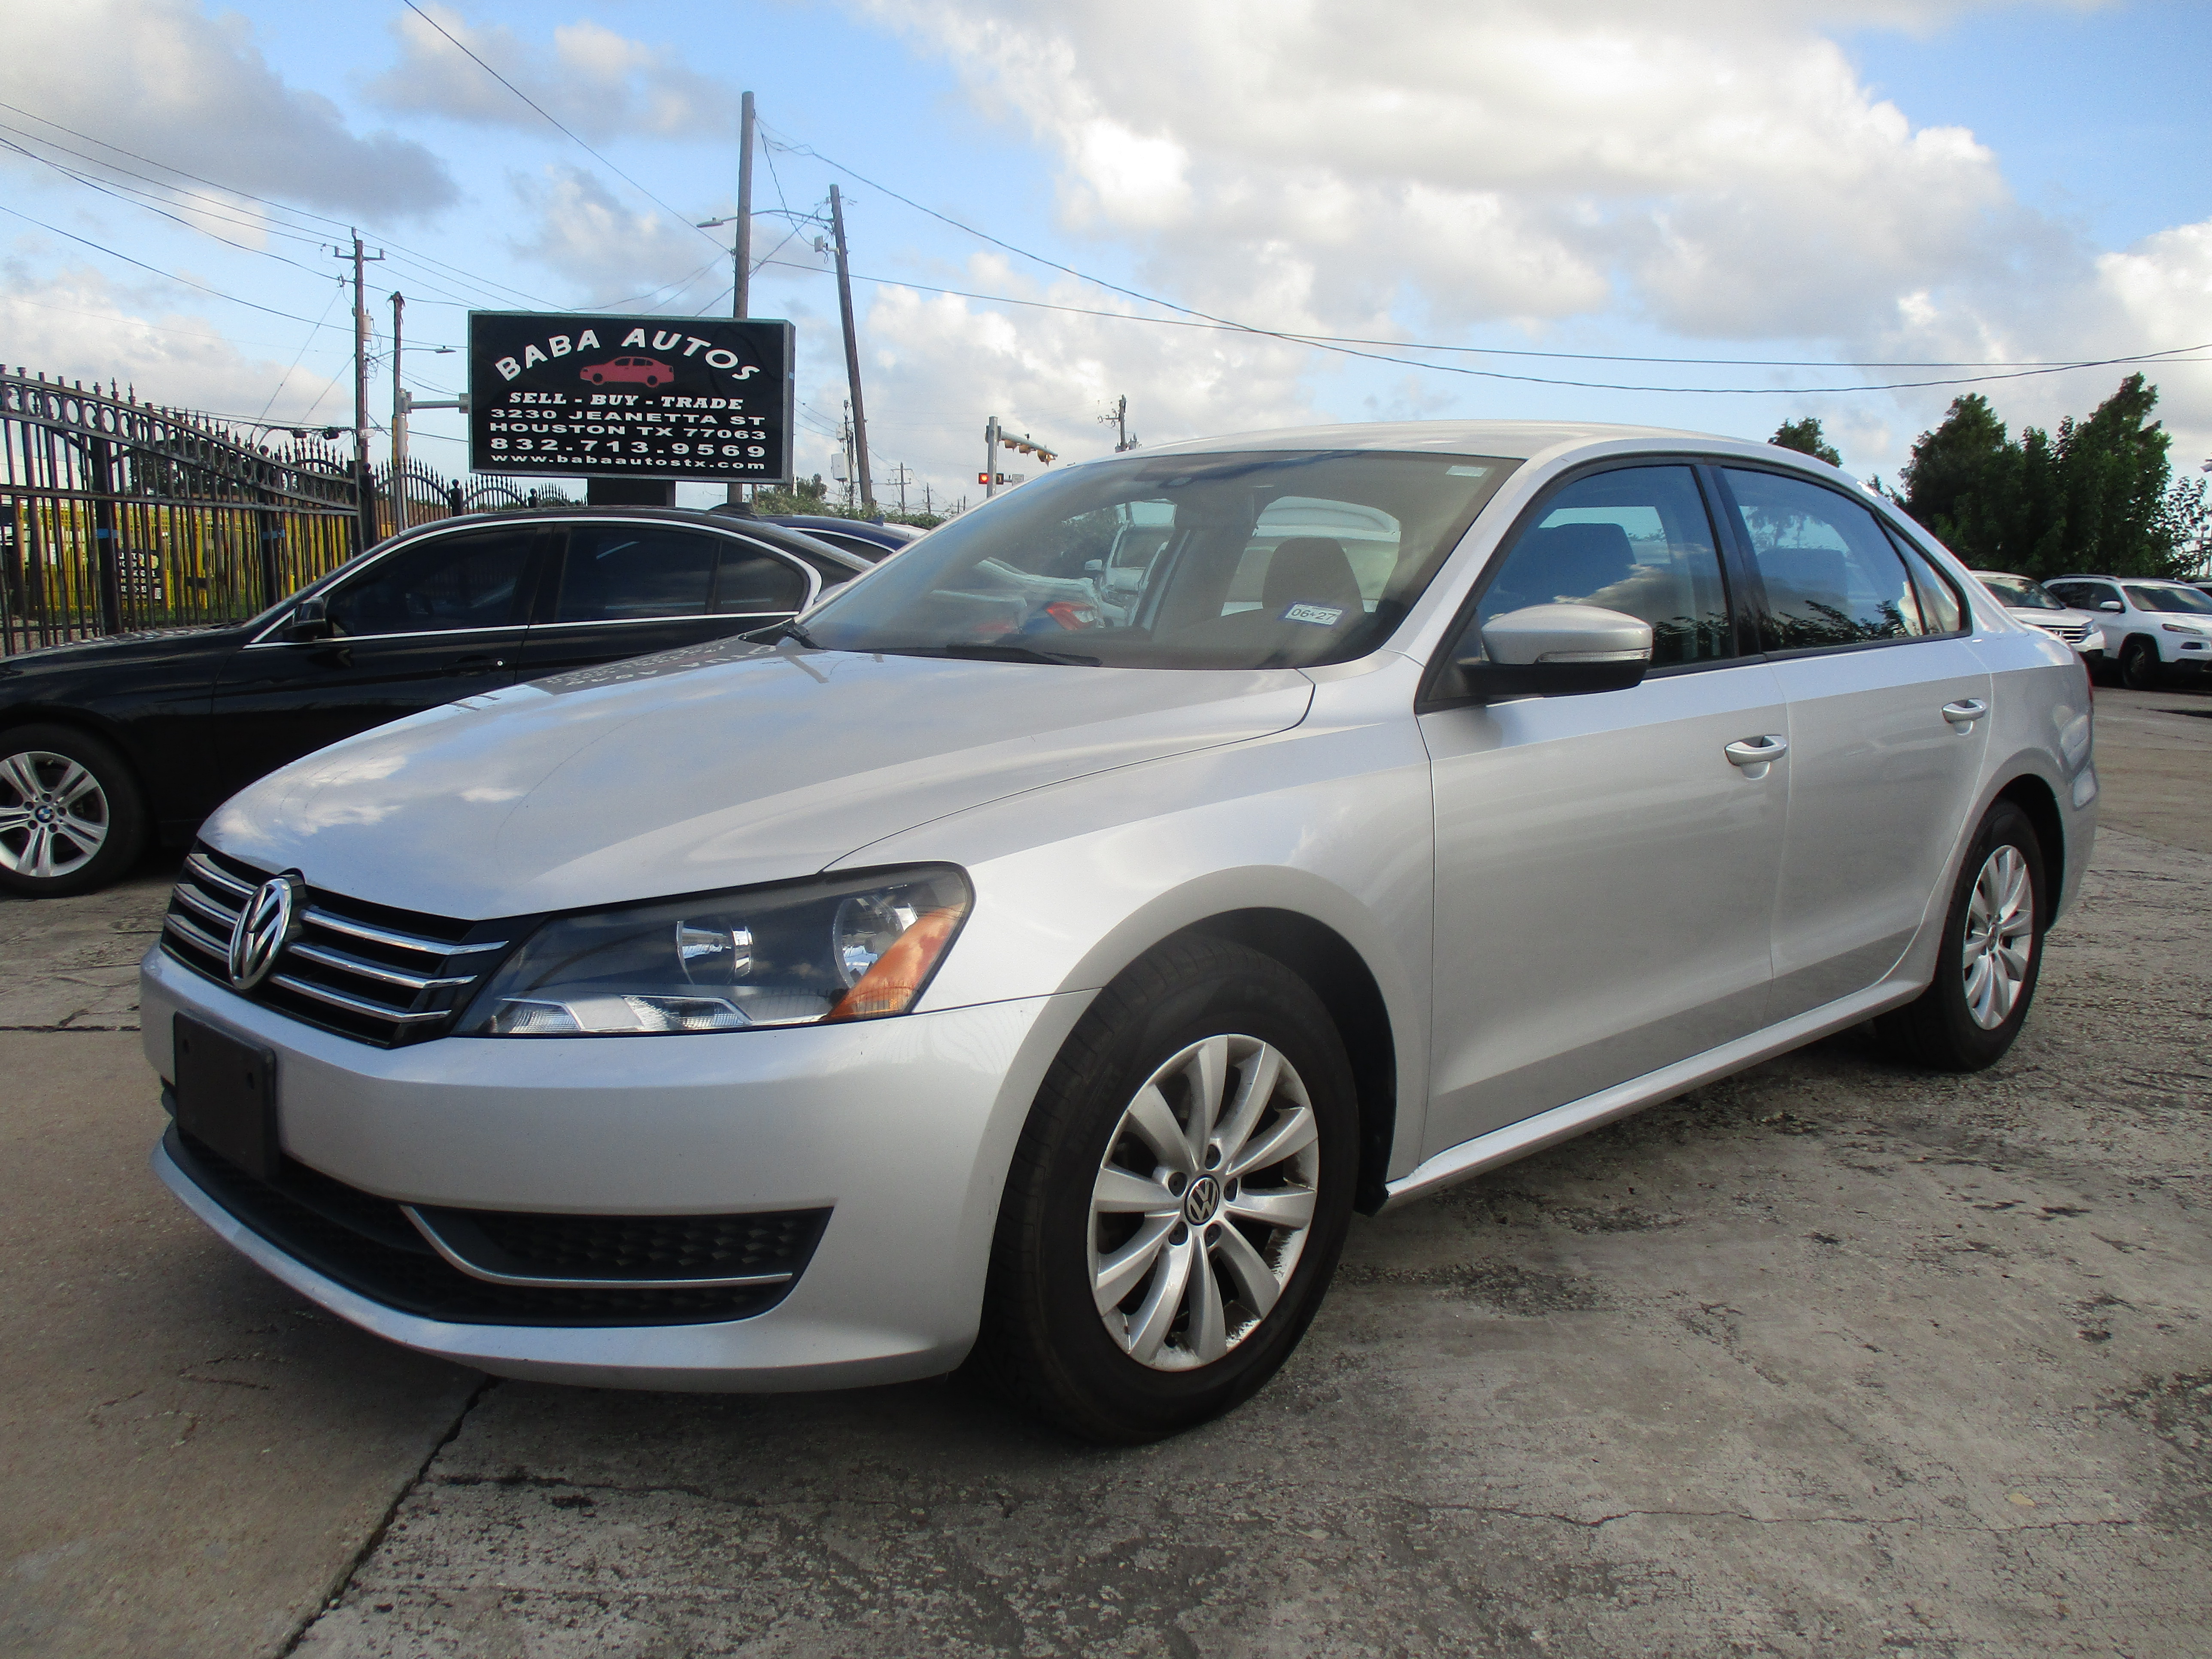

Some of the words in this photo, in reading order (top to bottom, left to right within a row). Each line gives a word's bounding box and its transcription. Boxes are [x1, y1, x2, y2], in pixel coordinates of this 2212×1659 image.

[495, 328, 601, 381] BABA
[621, 328, 760, 380] AUTOS
[509, 392, 567, 404] SELL
[590, 394, 639, 406] BUY
[661, 396, 743, 410] TRADE
[491, 409, 557, 419] 3230
[568, 411, 717, 424] JEANETTA
[730, 416, 766, 425] ST
[490, 422, 625, 434] HOUSTON
[636, 426, 673, 436] TX
[683, 428, 766, 440] 77063
[491, 438, 765, 458] 832.713.9569
[491, 455, 764, 469] www.babaautostx.com
